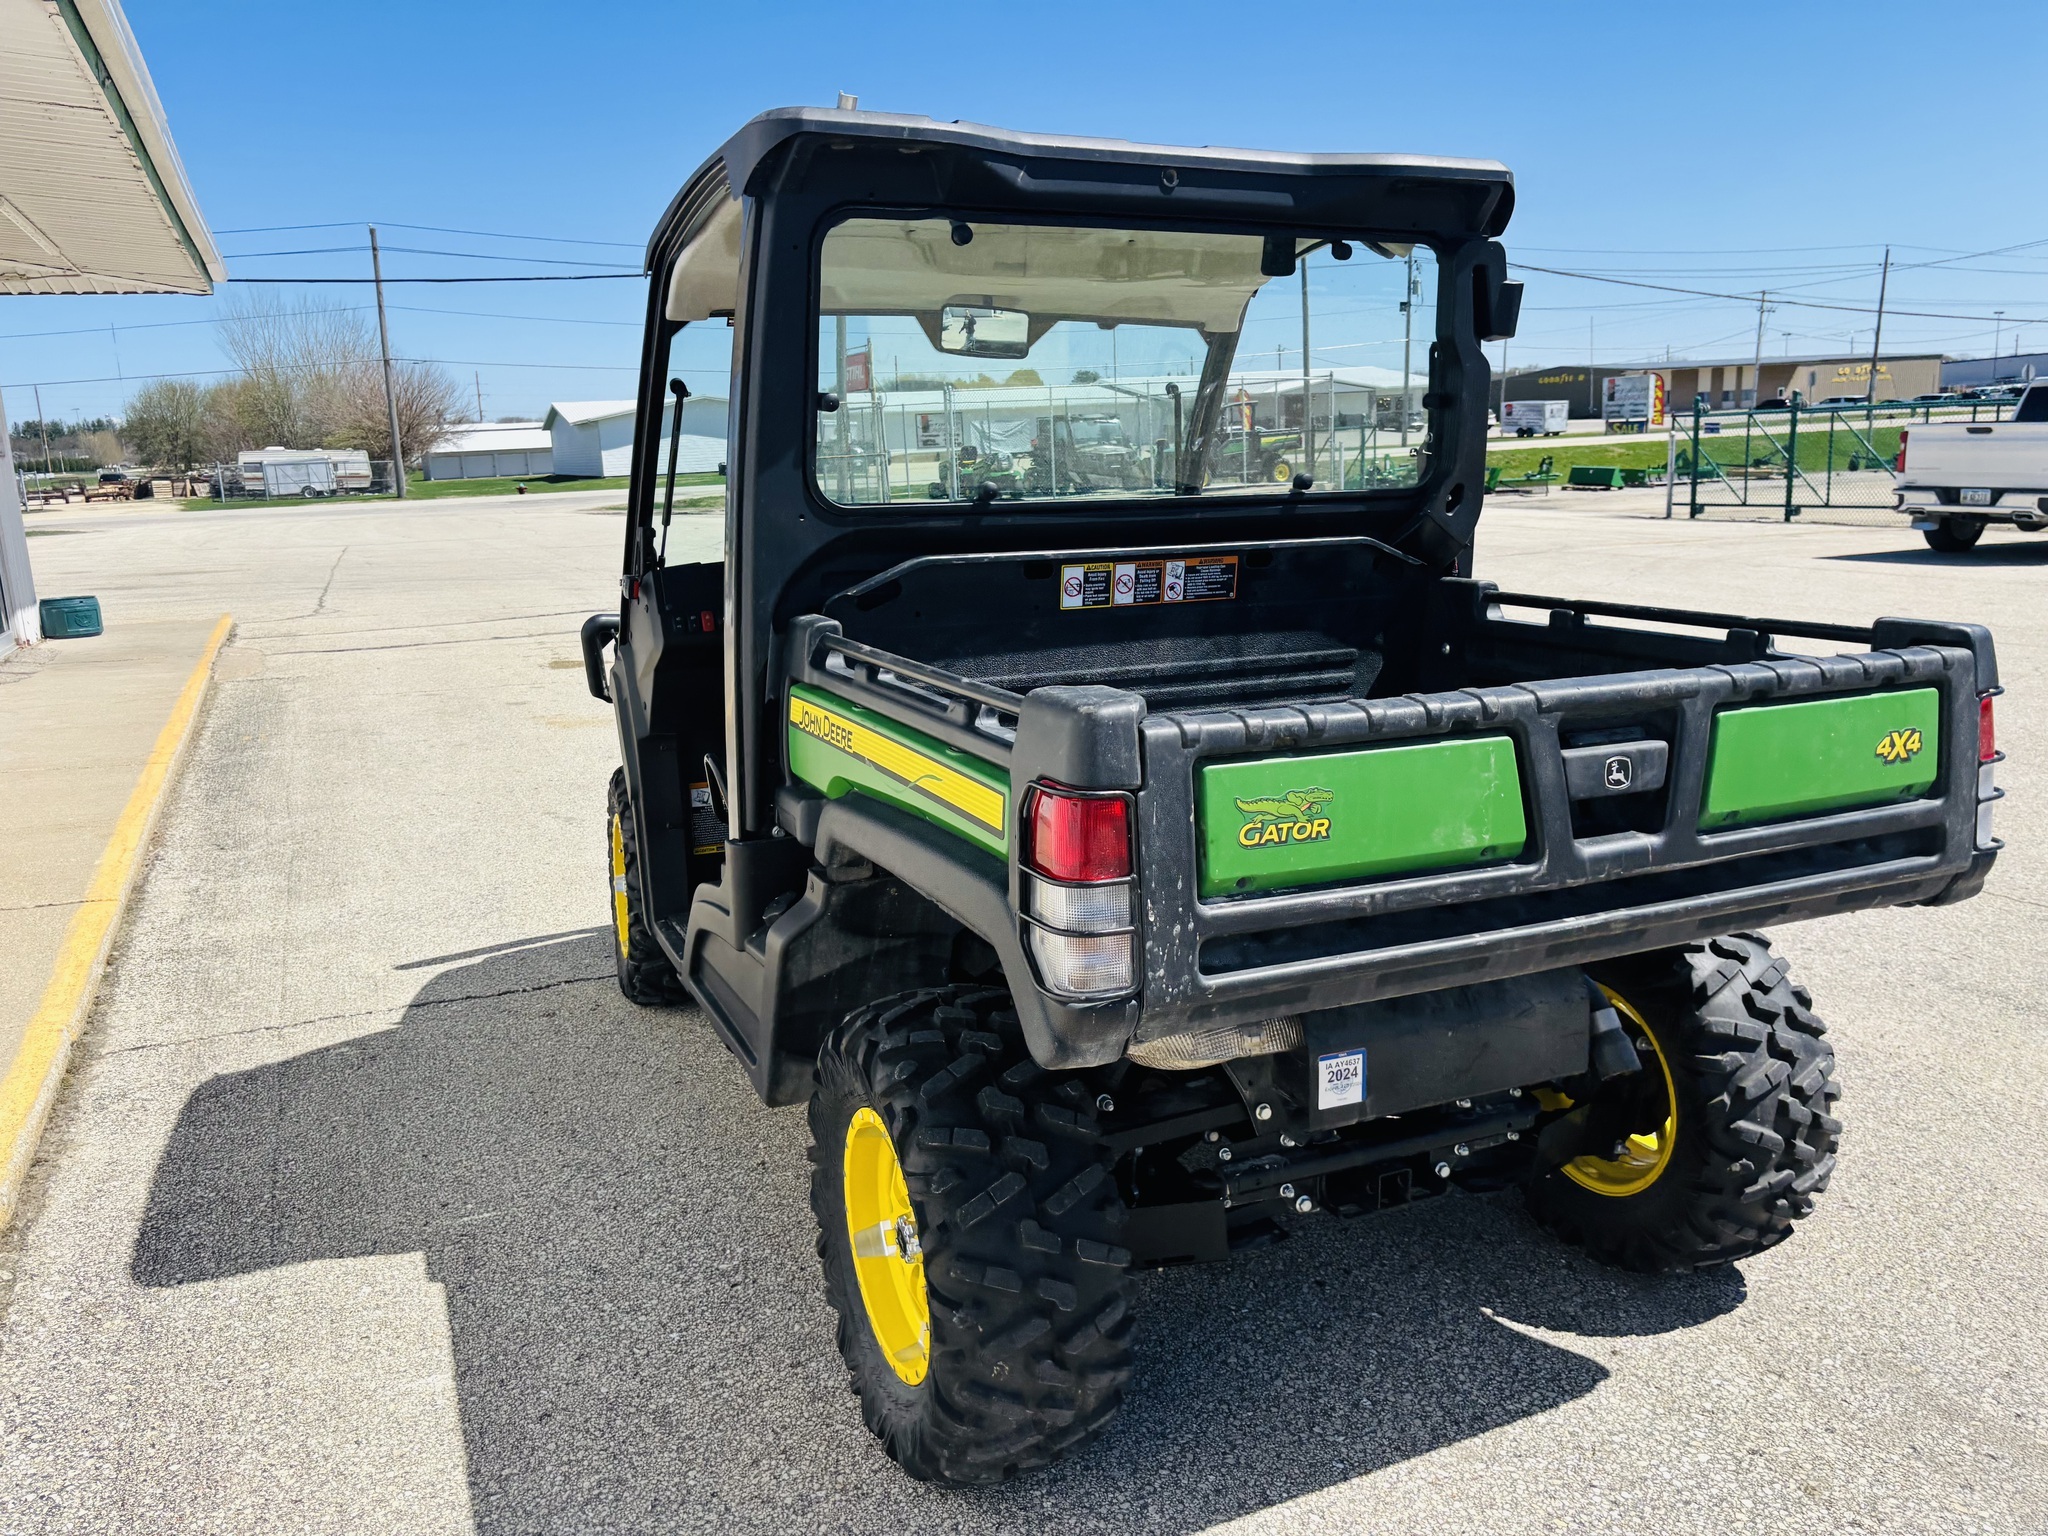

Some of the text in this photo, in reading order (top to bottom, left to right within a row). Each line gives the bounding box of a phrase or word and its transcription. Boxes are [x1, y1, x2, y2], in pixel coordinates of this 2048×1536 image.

[1612, 422, 1639, 434] SALE
[799, 705, 854, 750] JOHN DEERE
[1875, 729, 1922, 761] 4X4
[1238, 818, 1330, 847] GATOR
[1325, 1062, 1333, 1070] IA
[1327, 1066, 1358, 1083] 2024
